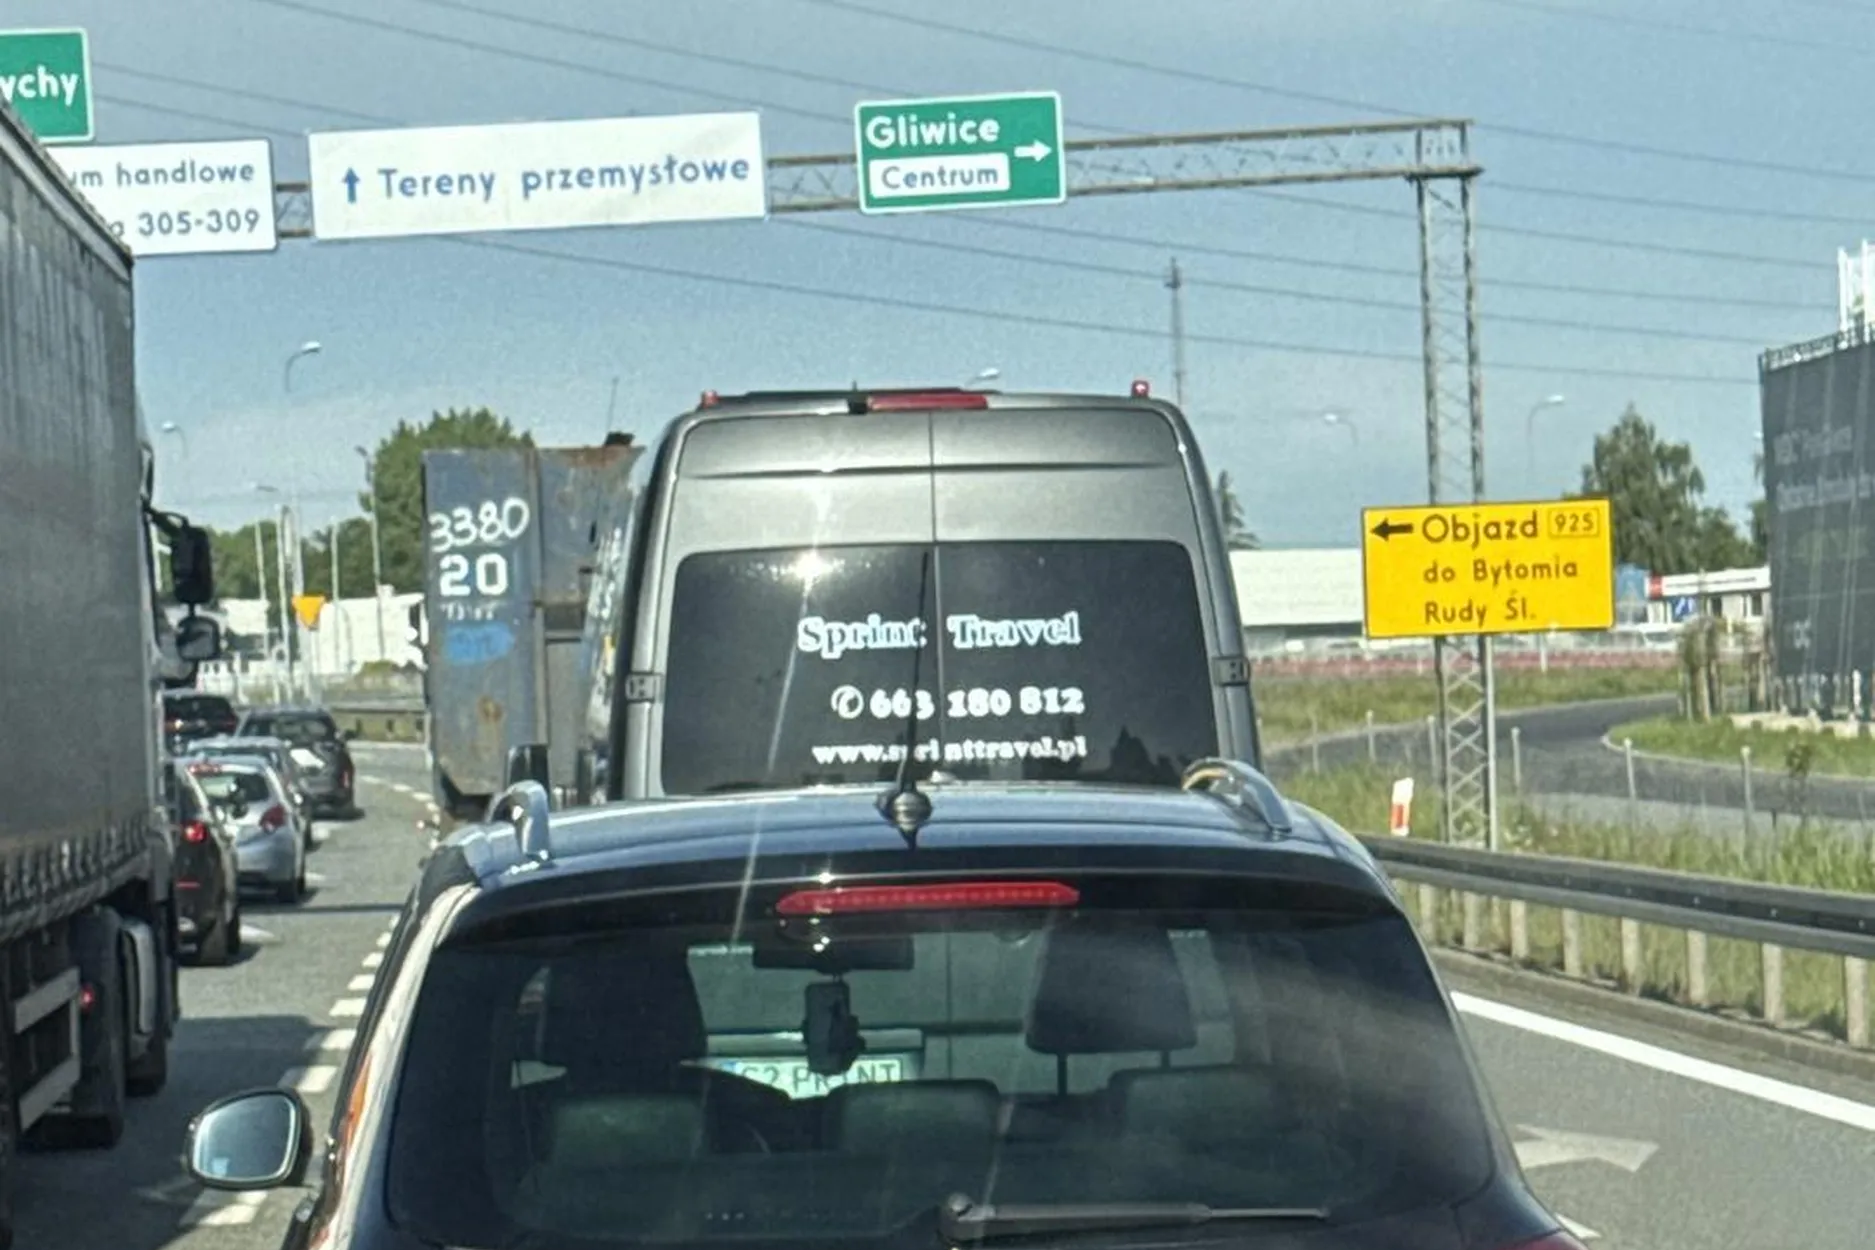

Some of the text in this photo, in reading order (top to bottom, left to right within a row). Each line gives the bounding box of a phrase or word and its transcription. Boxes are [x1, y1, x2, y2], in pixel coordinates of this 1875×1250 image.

[865, 110, 1001, 149] Gliwice
[116, 159, 255, 188] handlowe
[377, 153, 751, 202] Tereny przemysłowe
[881, 164, 999, 189] Centrum
[137, 208, 261, 236] 305-309
[427, 497, 530, 553] 3380
[1422, 510, 1594, 549] Objazd 925
[439, 553, 508, 597] 20
[1424, 554, 1579, 587] do Bytomia
[1424, 590, 1537, 627] Rudy Śl.
[946, 610, 1083, 650] Travel
[869, 685, 1085, 720] 663 180 812
